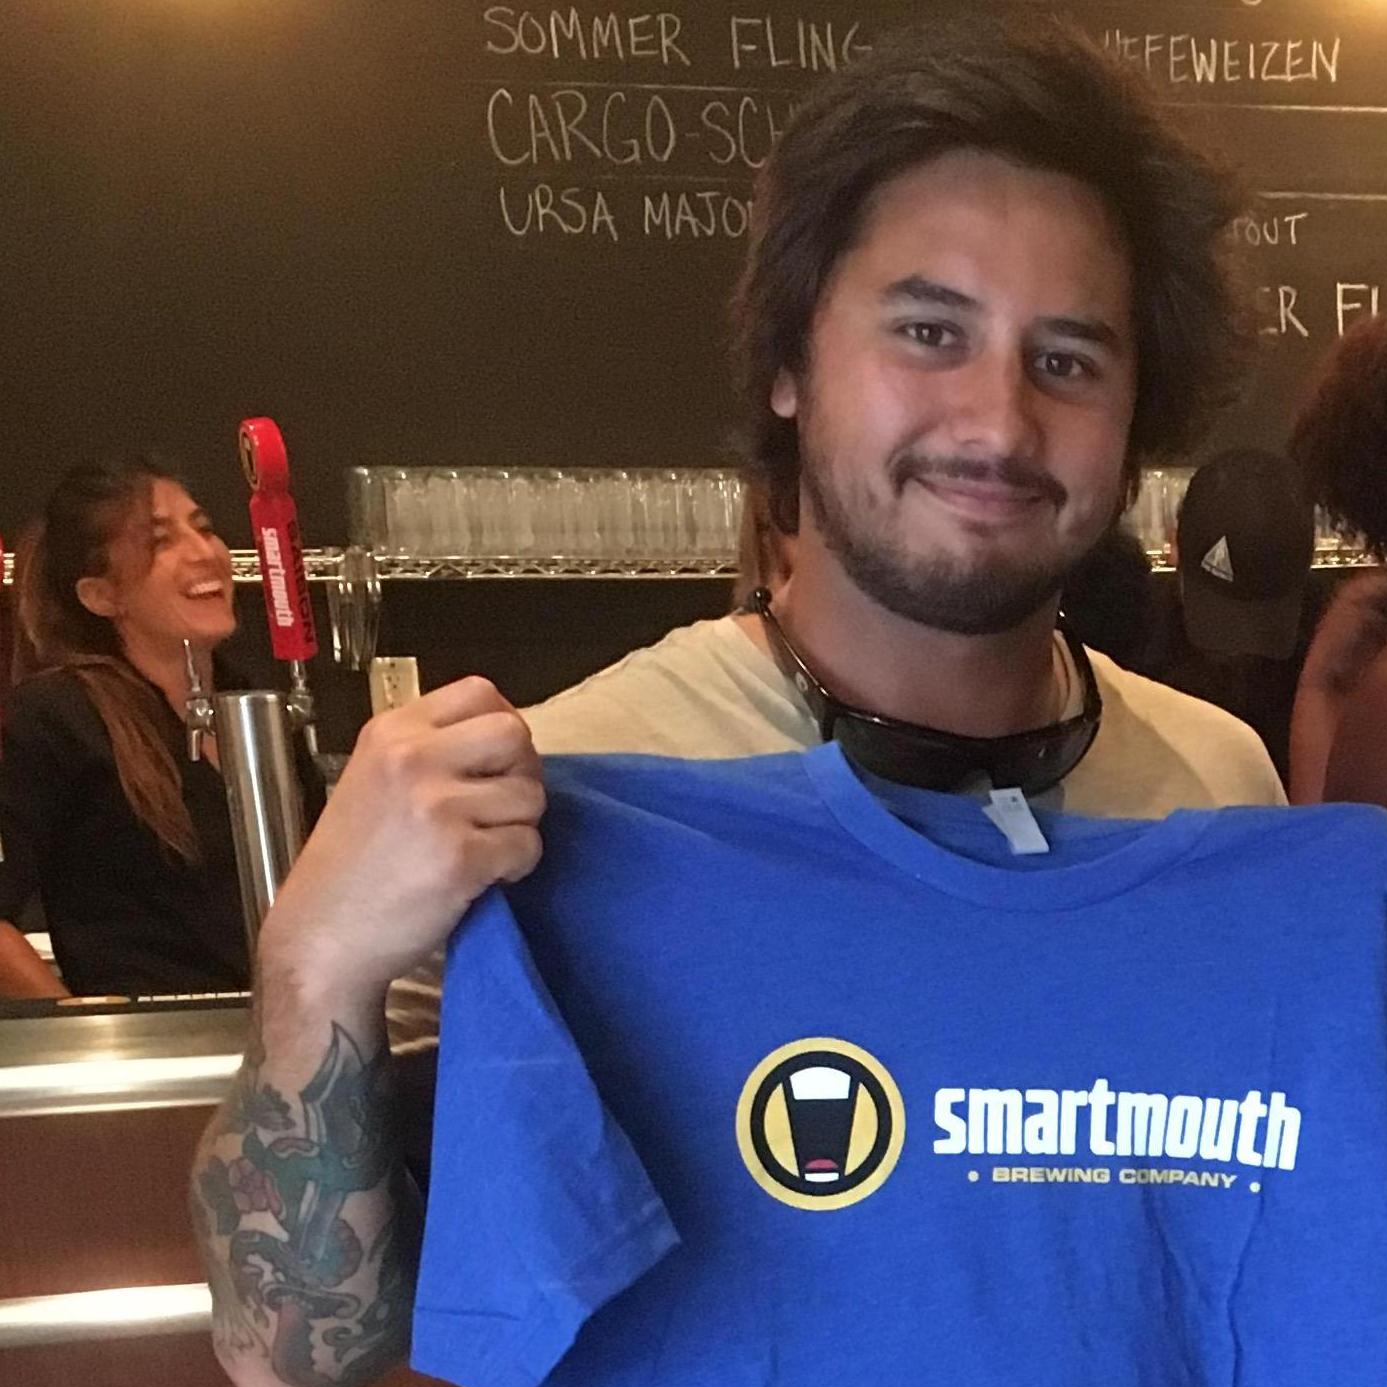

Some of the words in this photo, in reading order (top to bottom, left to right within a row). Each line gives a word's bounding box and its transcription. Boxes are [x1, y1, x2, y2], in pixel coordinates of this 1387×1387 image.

[483, 6, 691, 66] SOMMER
[731, 15, 874, 72] FLING
[500, 184, 618, 241] URSA
[933, 1078, 1302, 1171] smartmouth
[992, 1166, 1111, 1184] BREWING
[1118, 1168, 1238, 1189] COMPANY
